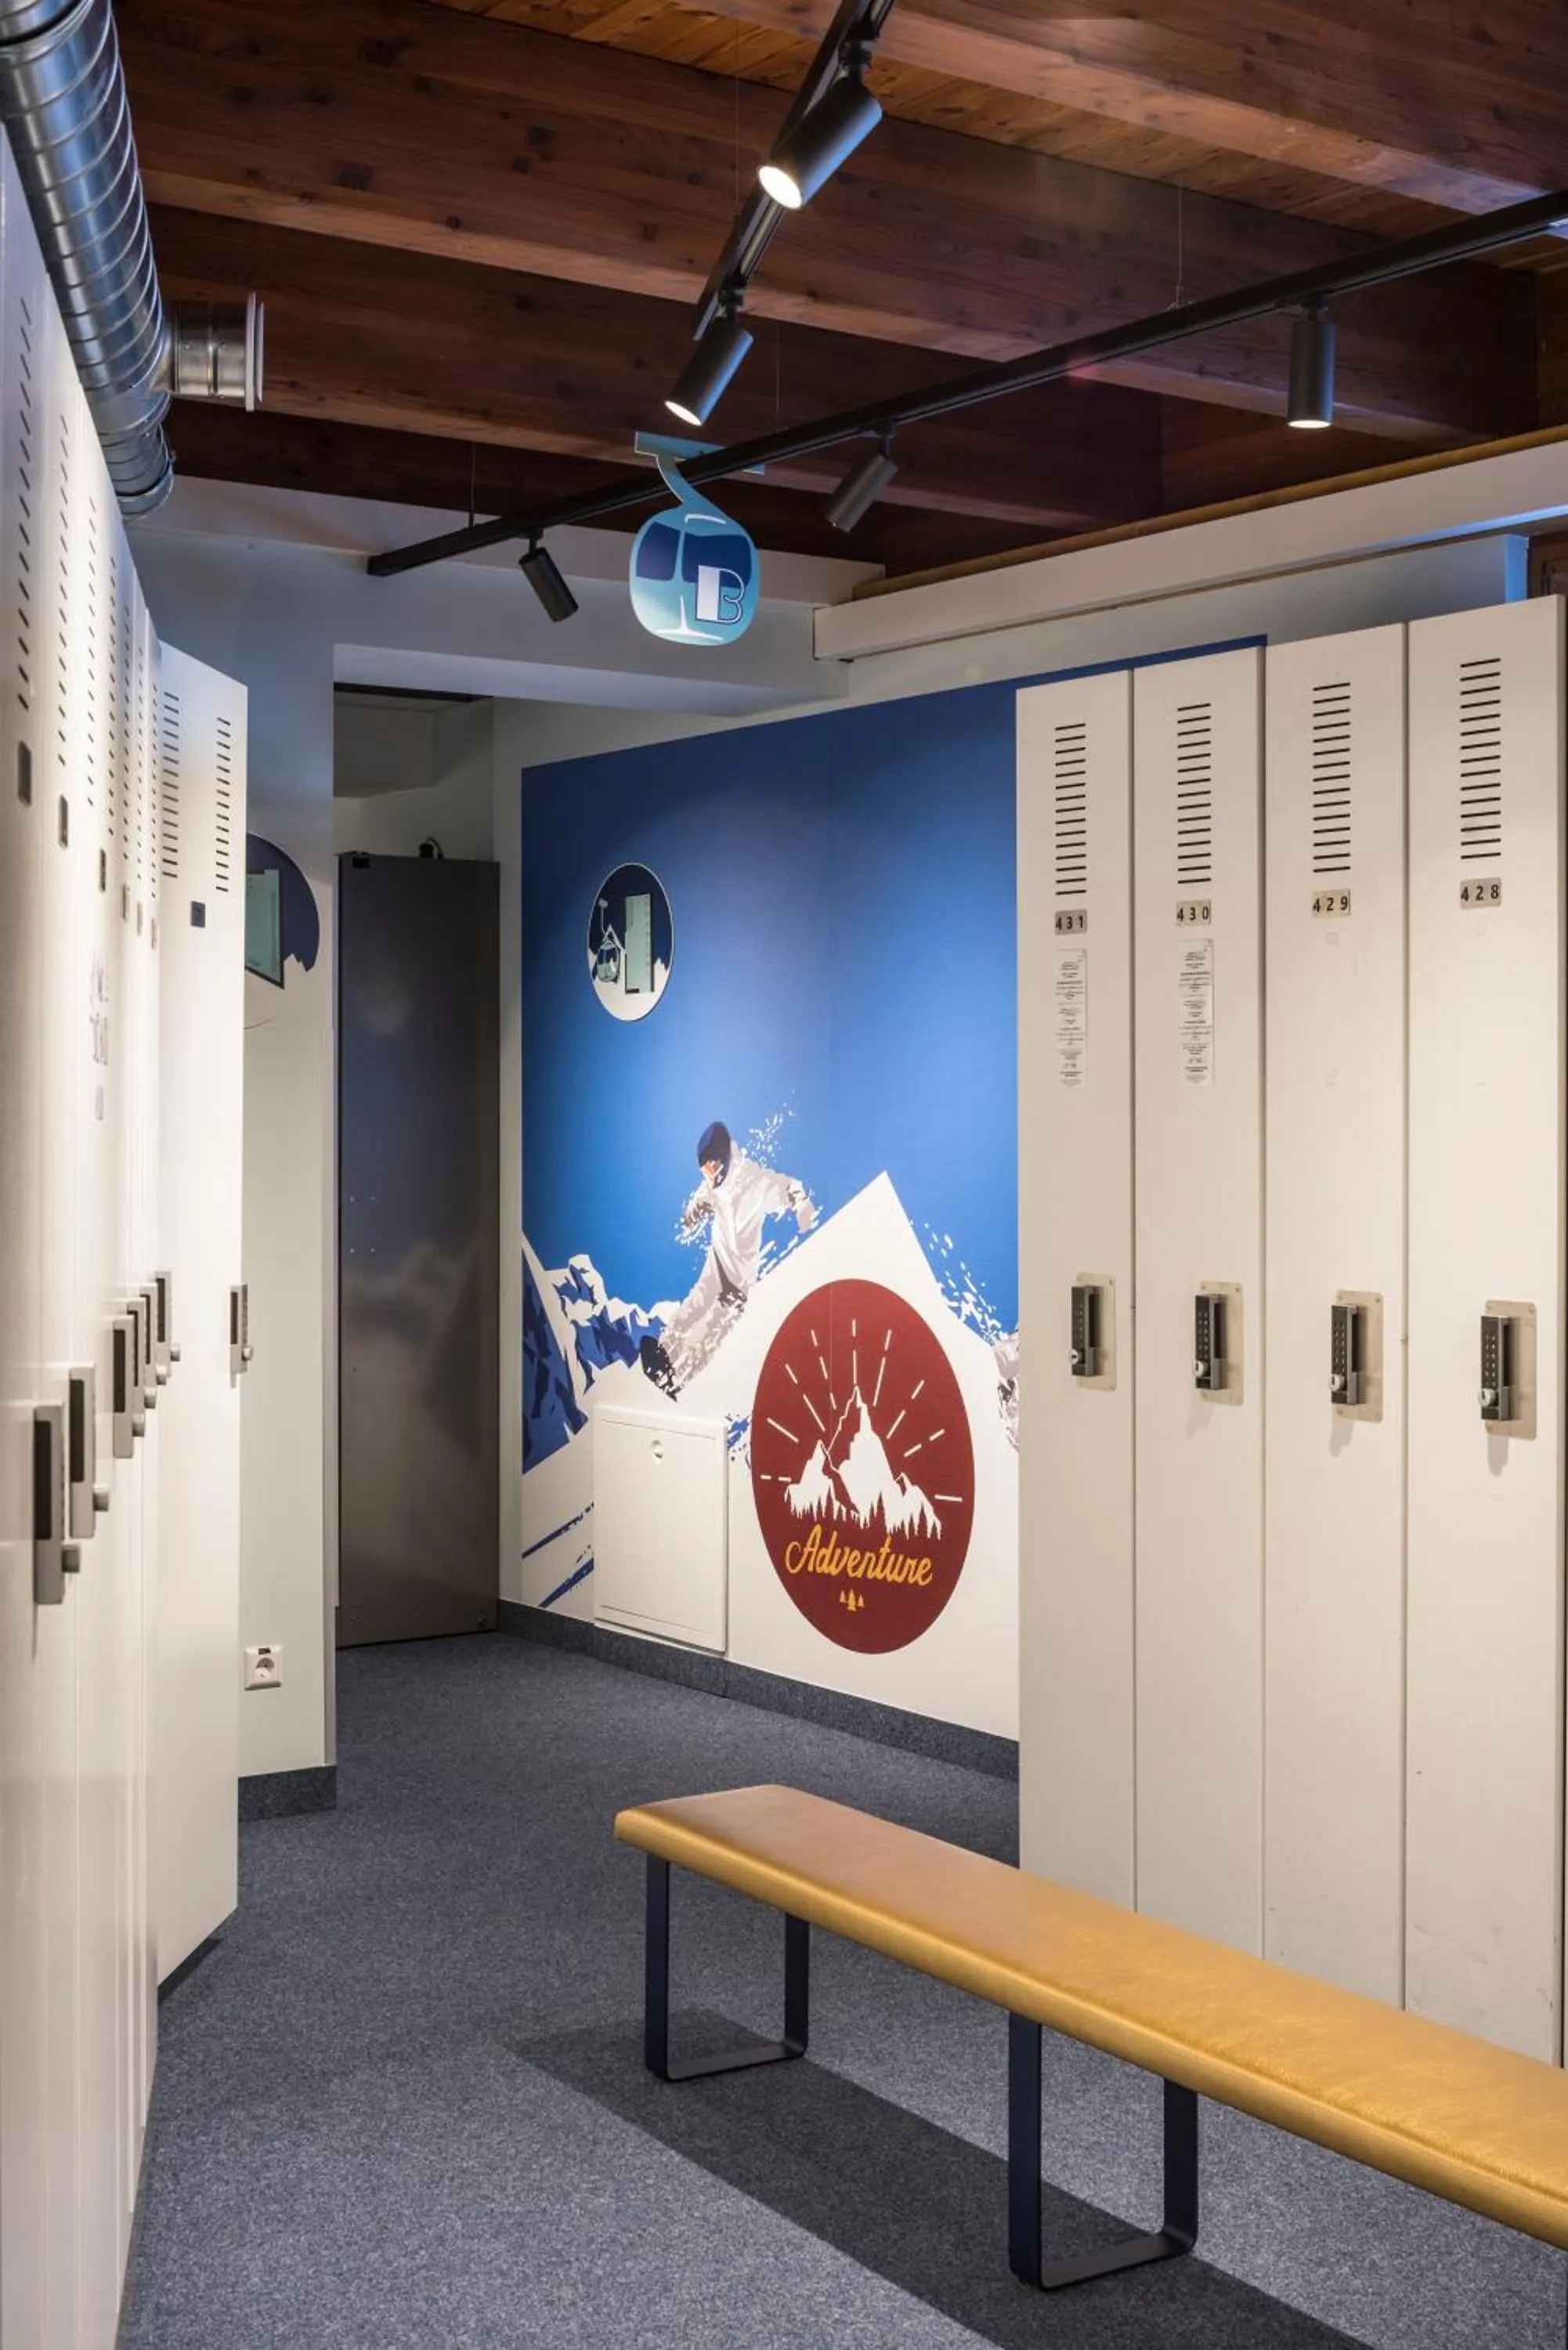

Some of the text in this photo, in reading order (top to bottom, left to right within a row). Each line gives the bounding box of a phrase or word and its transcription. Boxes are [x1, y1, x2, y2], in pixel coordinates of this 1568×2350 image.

[1461, 884, 1499, 902] 428
[1312, 896, 1349, 913] 429
[1177, 906, 1209, 922] 430
[1056, 915, 1083, 931] 431
[786, 1524, 934, 1586] Adventure
